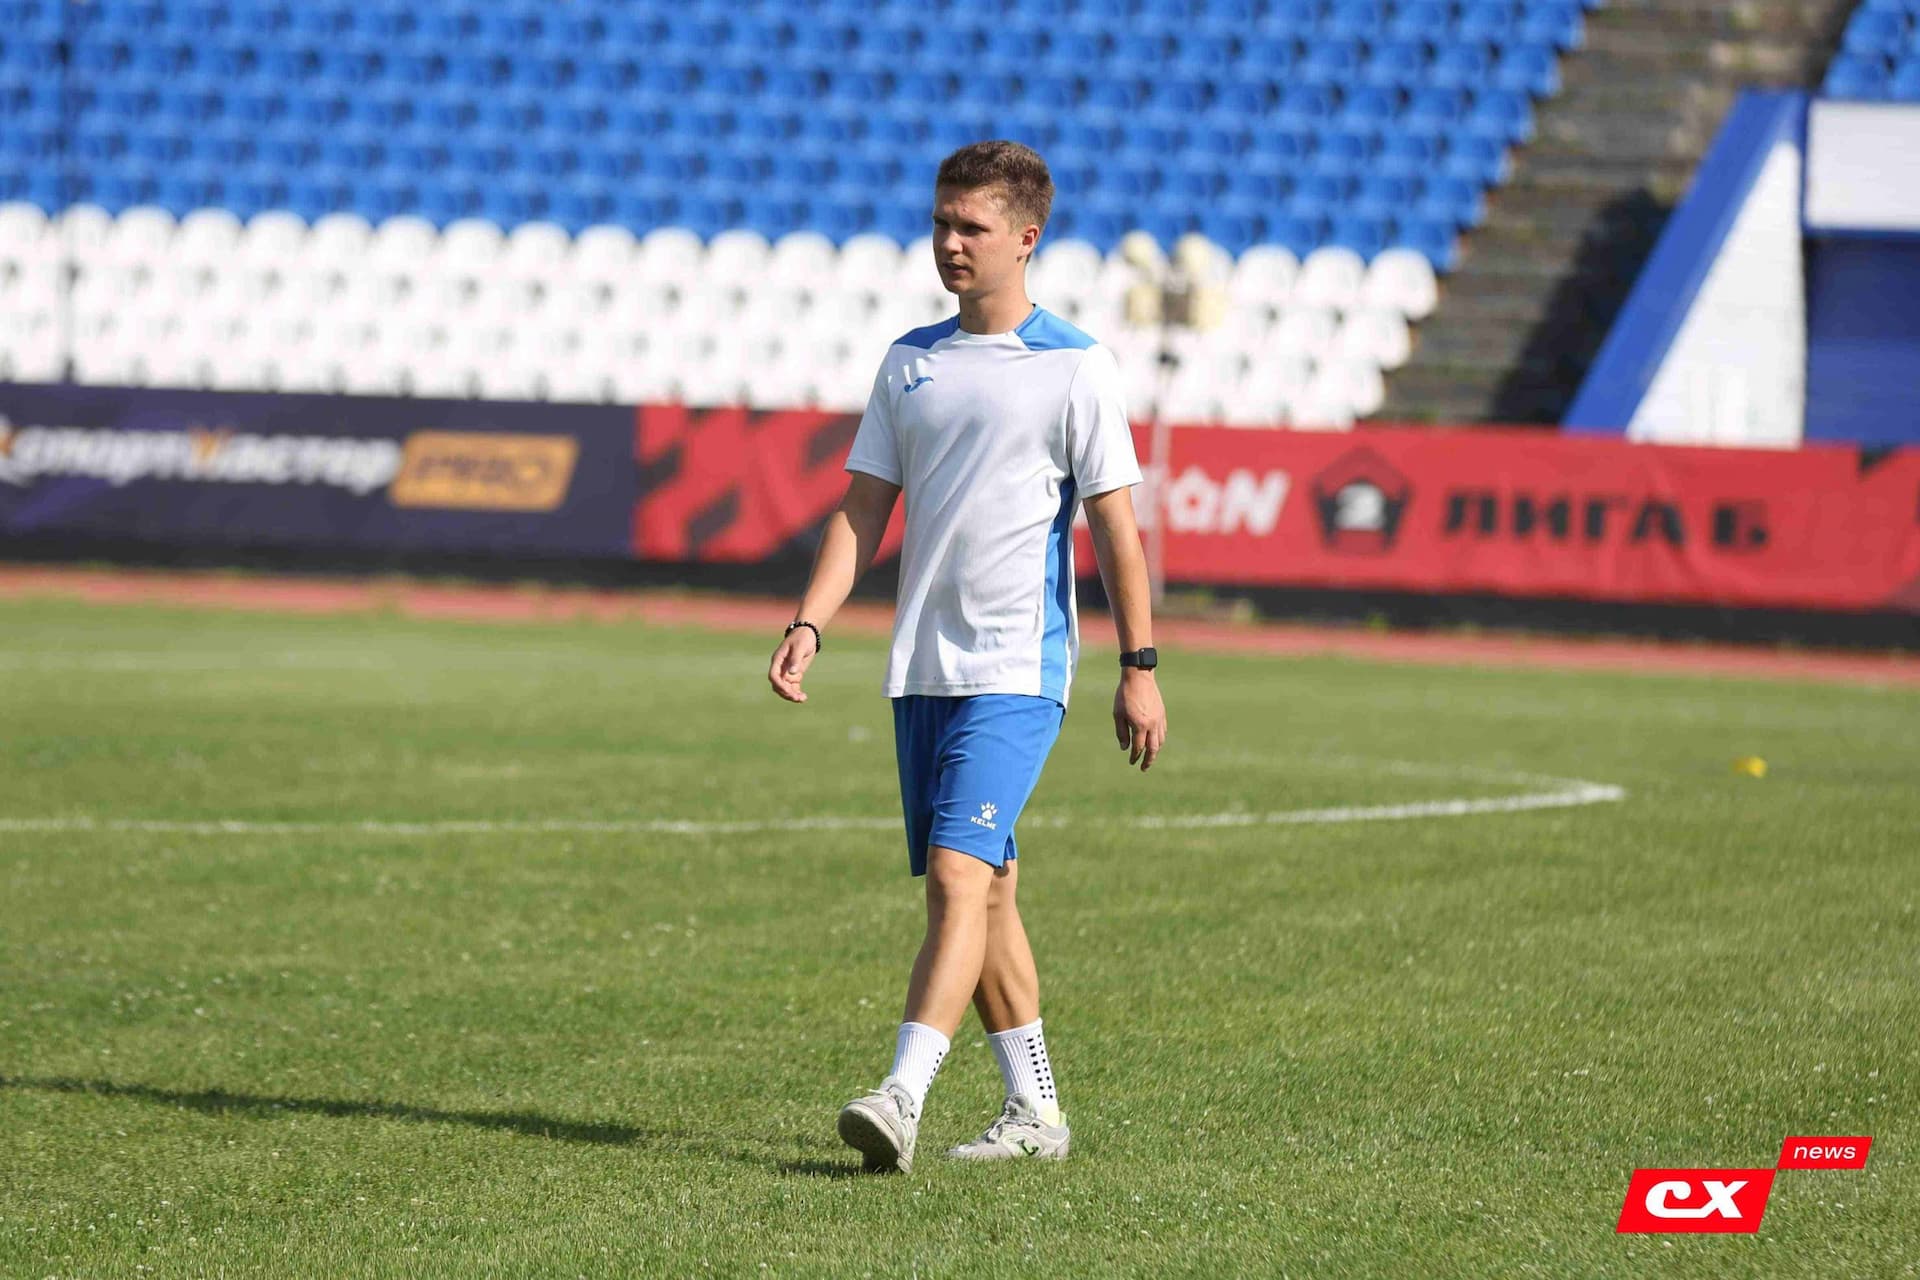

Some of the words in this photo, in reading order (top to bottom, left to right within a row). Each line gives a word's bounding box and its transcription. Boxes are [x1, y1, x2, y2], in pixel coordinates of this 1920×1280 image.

[1443, 489, 1686, 546] ЛИГА
[1711, 498, 1768, 549] Б
[970, 815, 997, 830] KELME
